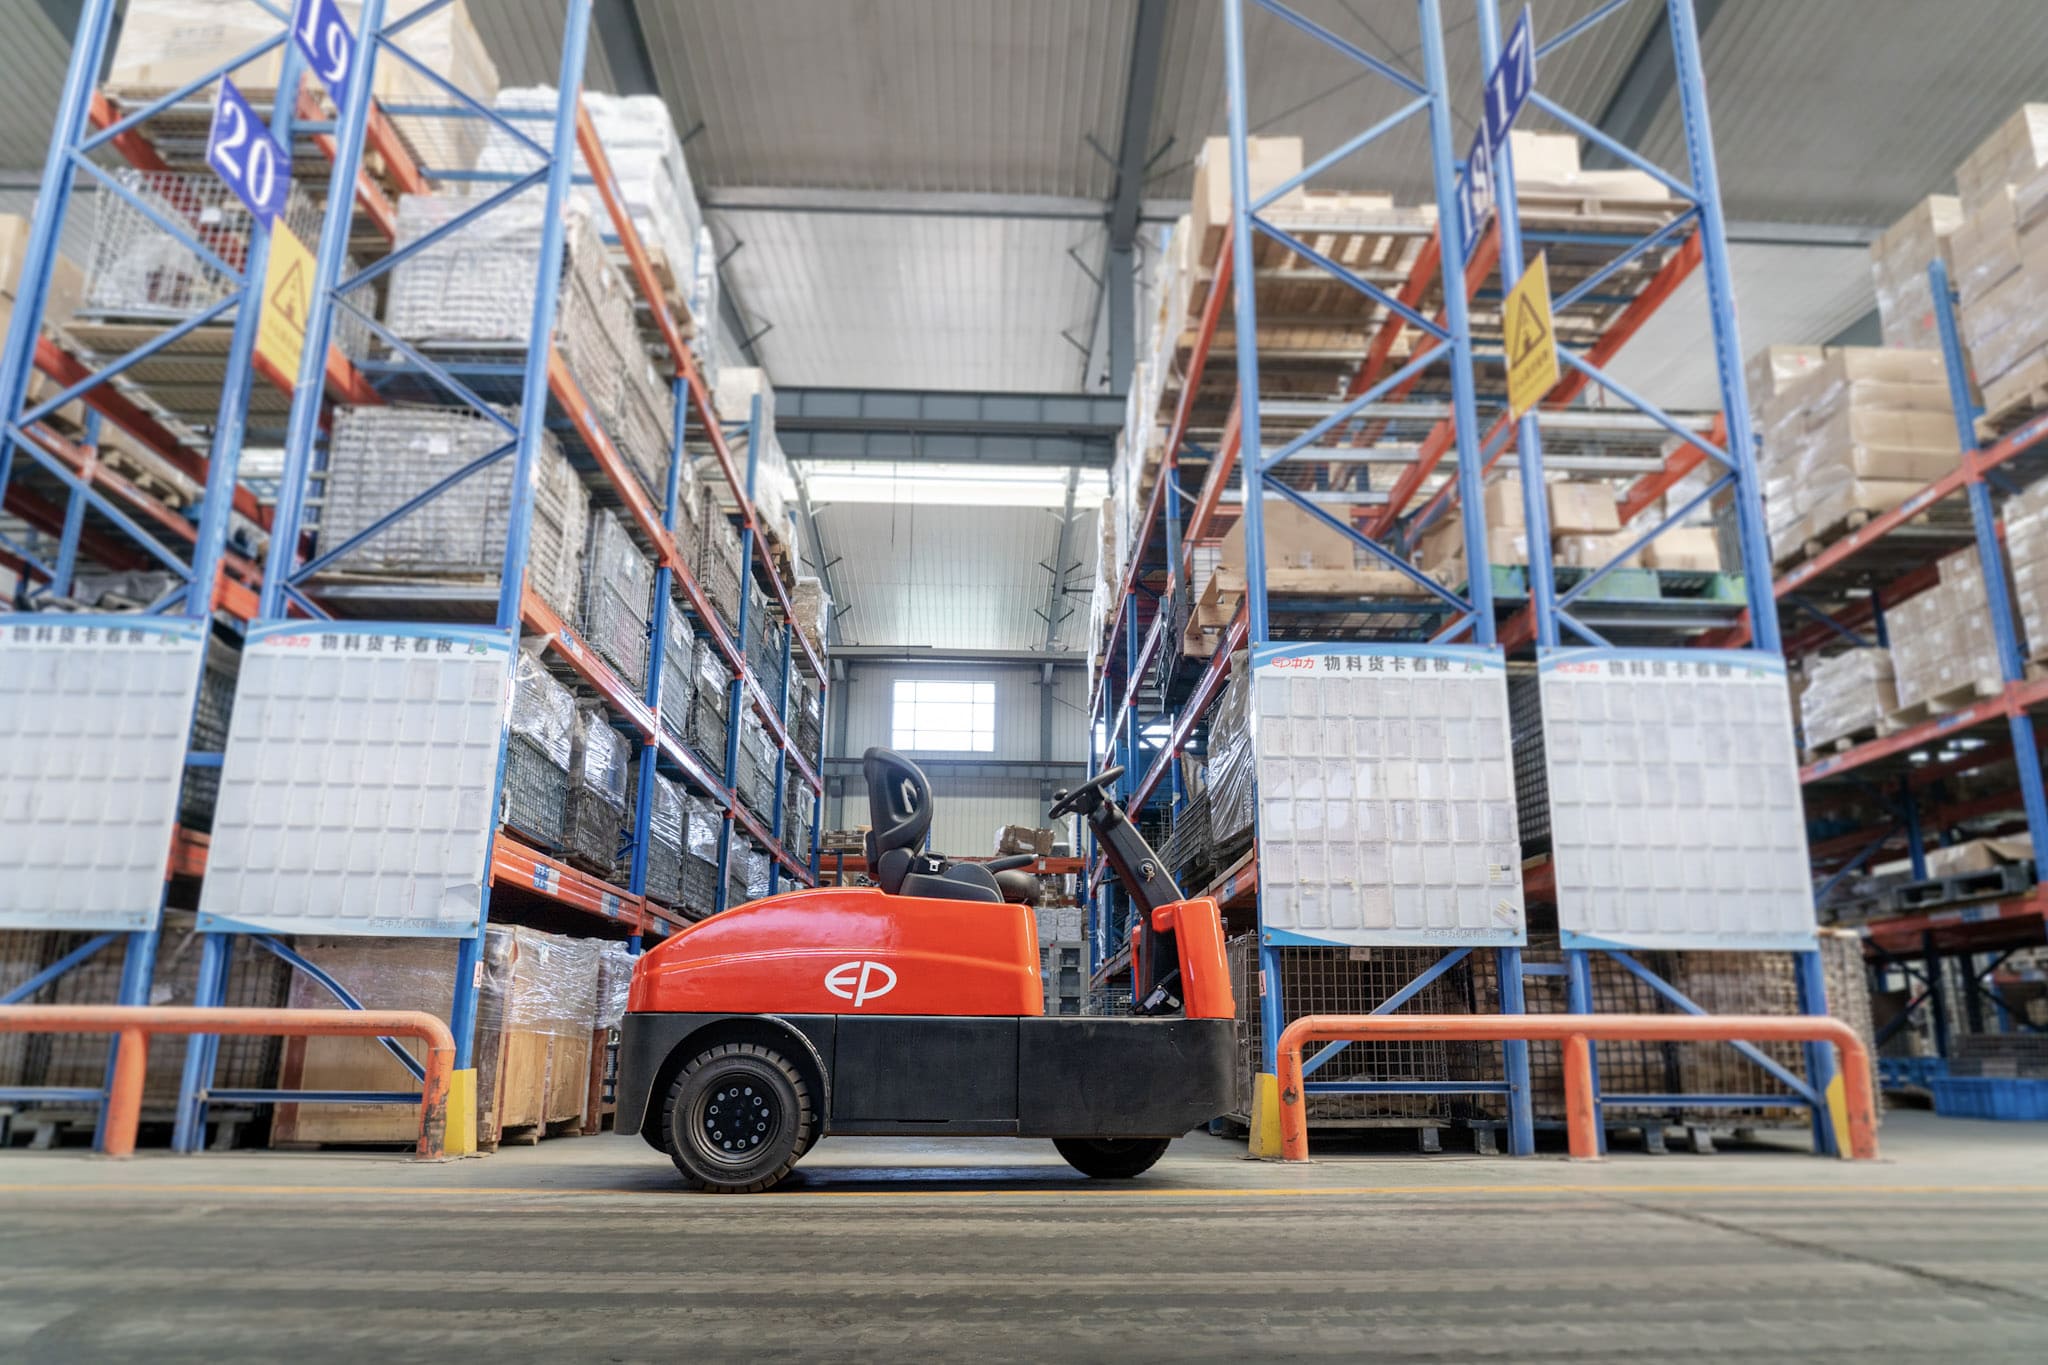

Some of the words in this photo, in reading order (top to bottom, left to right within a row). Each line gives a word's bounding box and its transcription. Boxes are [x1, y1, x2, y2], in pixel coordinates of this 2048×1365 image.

[299, 0, 348, 83] 19
[214, 99, 275, 207] 20
[321, 633, 454, 654] 物料货卡看板
[1323, 655, 1451, 672] 物料货卡看板
[824, 960, 898, 1008] EP
